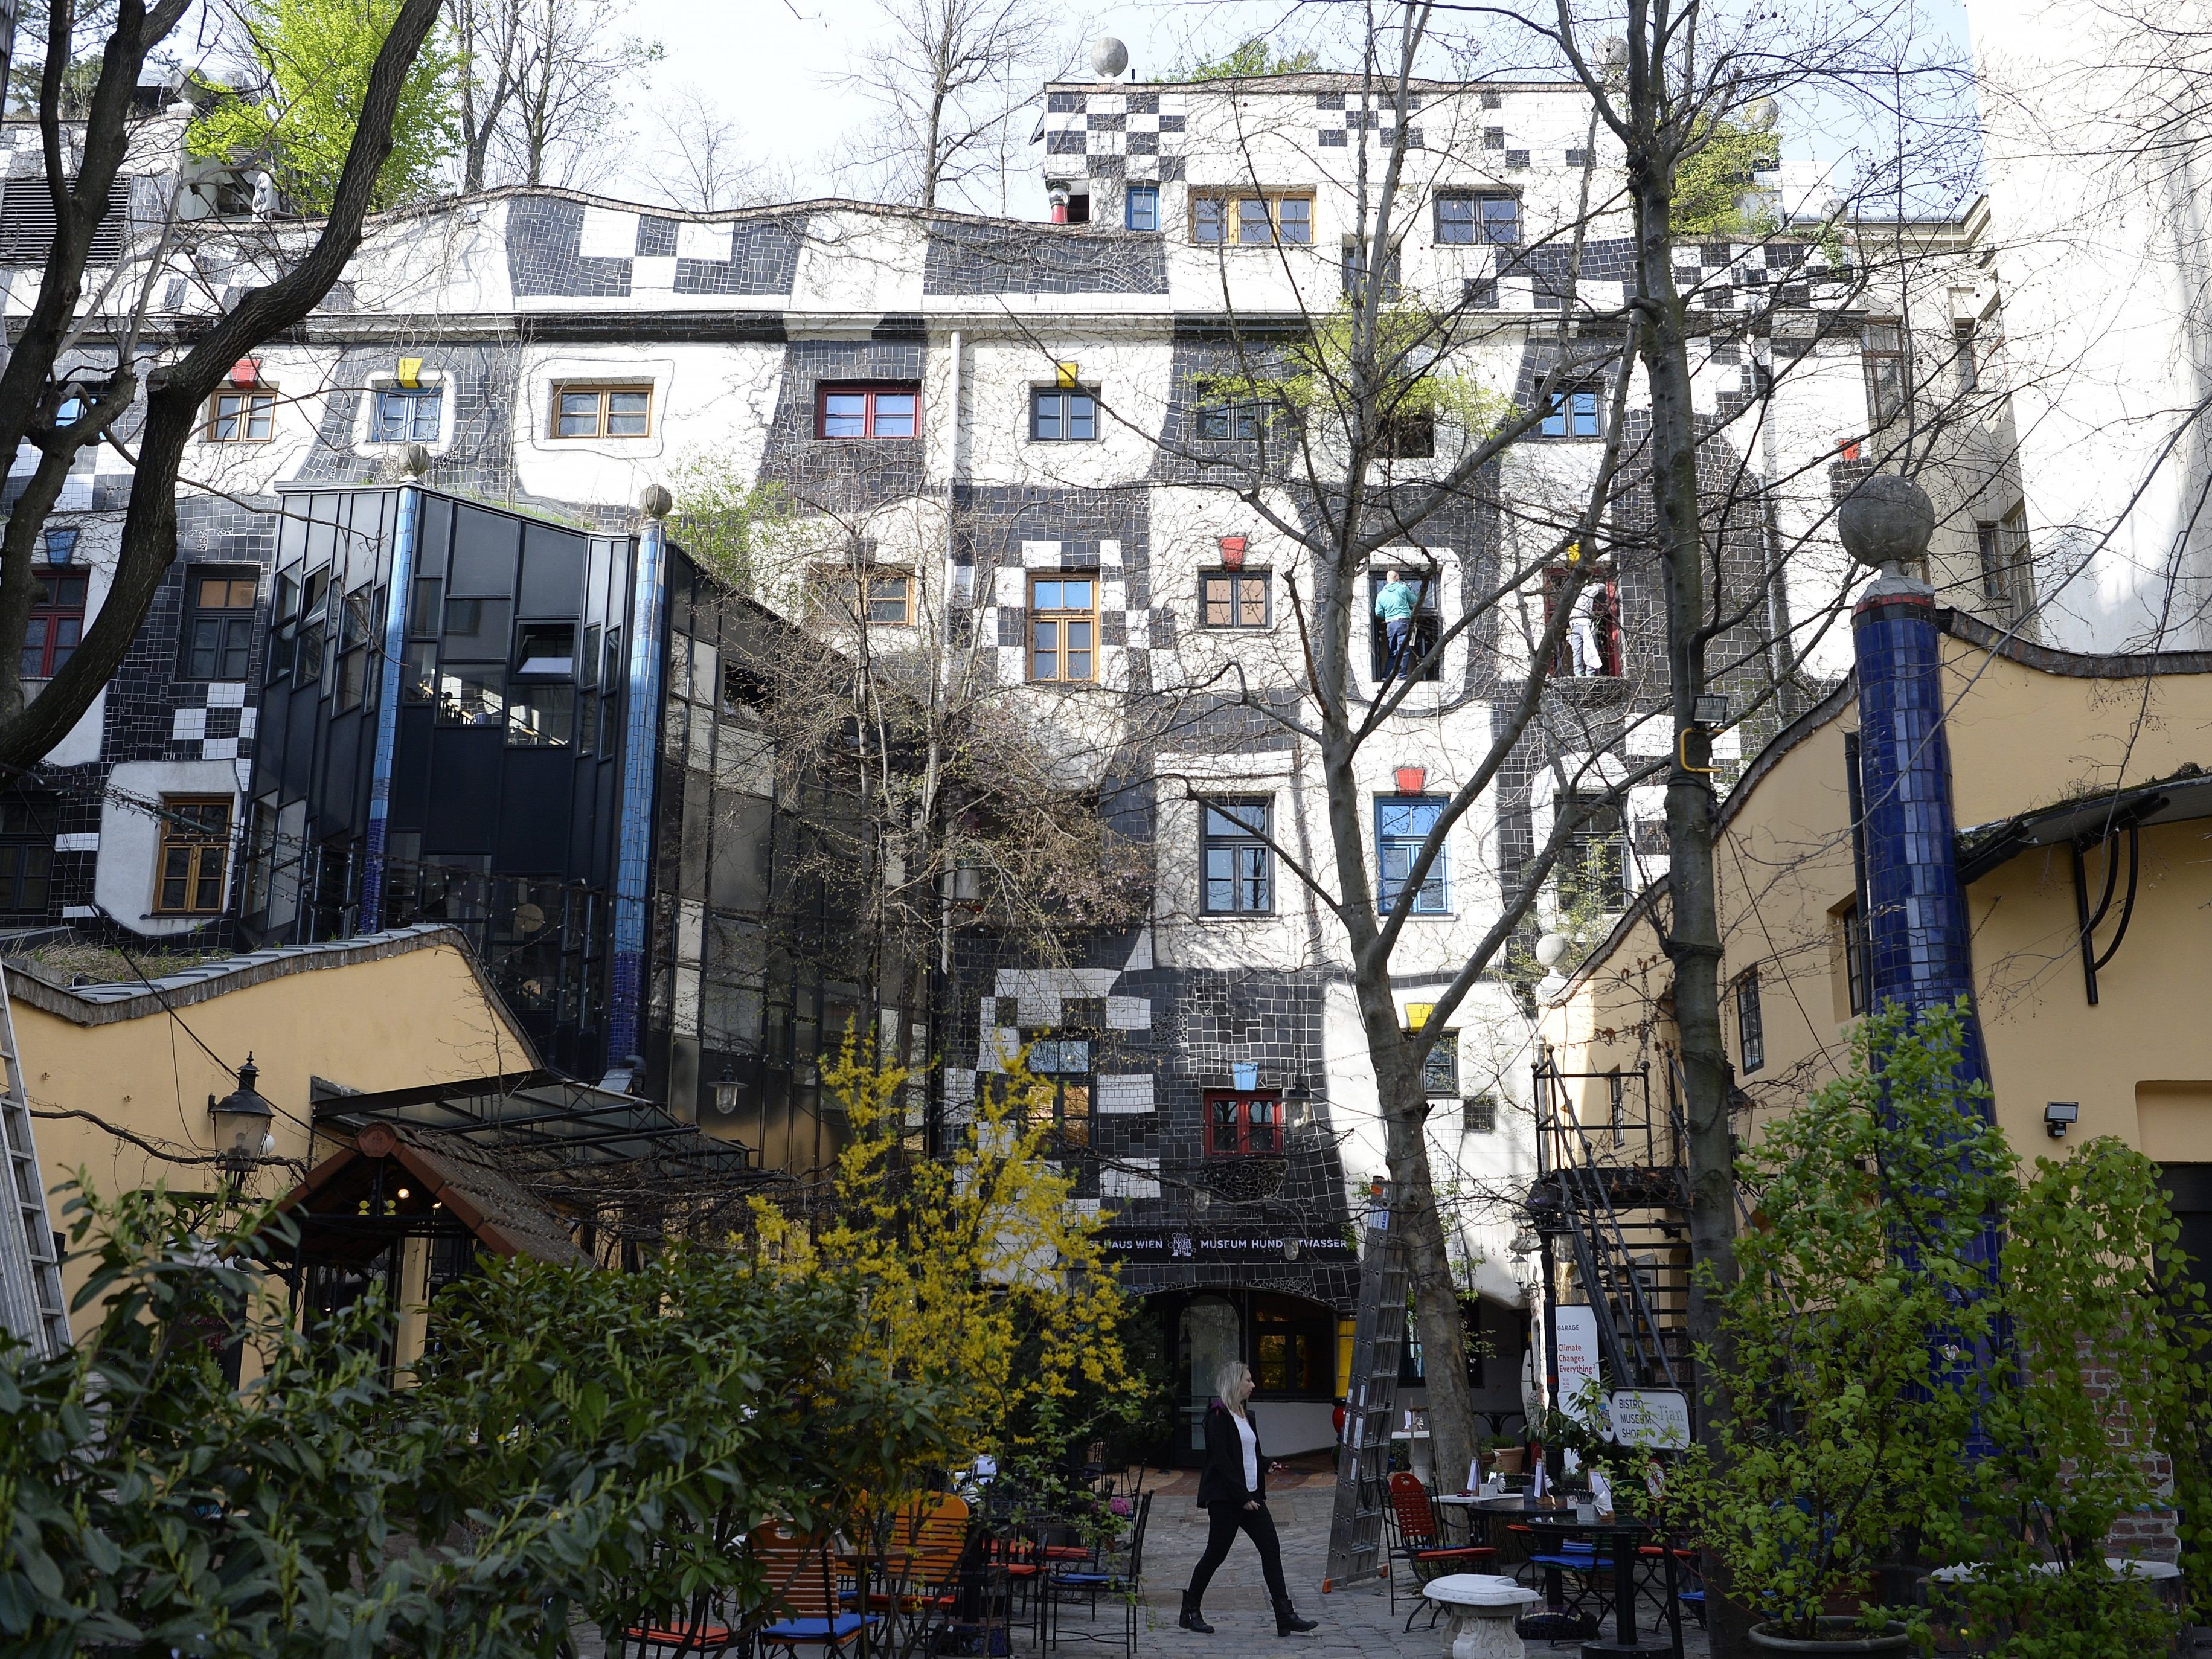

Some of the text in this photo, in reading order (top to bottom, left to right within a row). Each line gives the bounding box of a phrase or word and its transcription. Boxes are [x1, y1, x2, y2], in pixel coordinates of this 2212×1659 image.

[1104, 1240, 1133, 1249] HAUS
[1135, 1240, 1163, 1249] WIEN
[1201, 1239, 1247, 1249] MUSEUM
[1251, 1239, 1347, 1249] HUNDTWASSER
[1559, 1355, 1585, 1364] Changes
[1619, 1399, 1644, 1410] BISTRO
[1658, 1405, 1684, 1421] Tian
